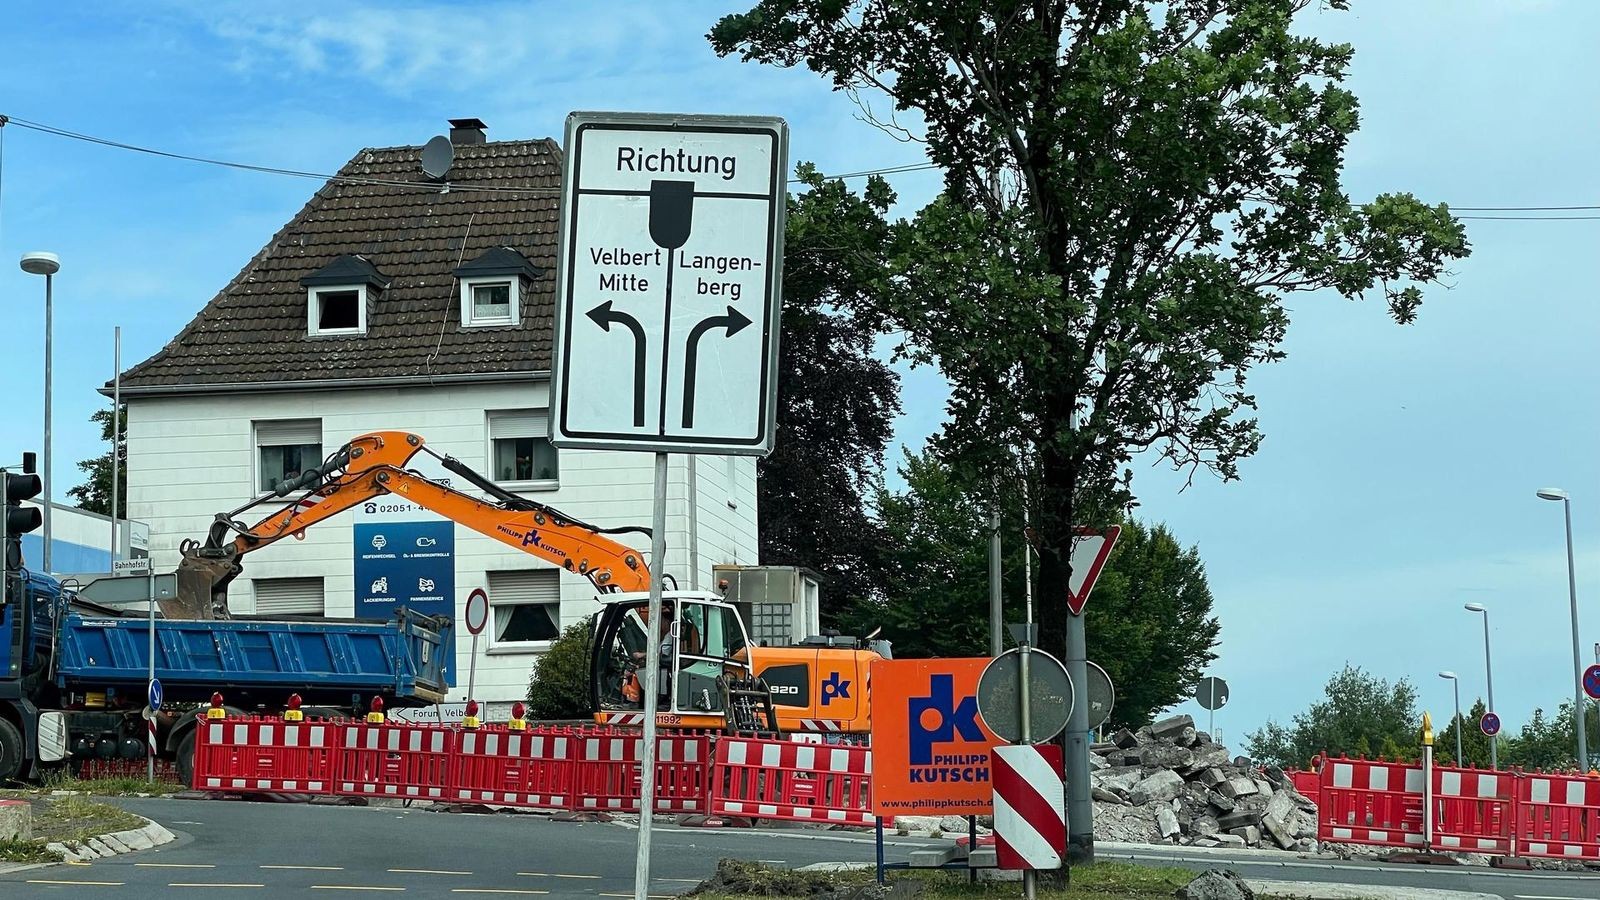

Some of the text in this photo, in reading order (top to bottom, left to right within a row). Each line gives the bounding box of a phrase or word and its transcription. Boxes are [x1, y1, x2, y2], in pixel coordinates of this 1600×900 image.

[617, 147, 736, 180] Richtung
[590, 247, 661, 266] Velbert
[680, 250, 762, 274] Langen-
[599, 273, 649, 292] Mitte
[697, 277, 741, 300] berg
[497, 525, 523, 539] PHILIPP
[540, 543, 566, 557] KUTSCH
[770, 685, 799, 694] 920
[444, 709, 468, 717] Velbe
[656, 715, 681, 724] 11992
[934, 754, 989, 766] PHILIPP
[909, 767, 989, 783] KUTSCH
[881, 799, 993, 809] www.philippkutsch.d
